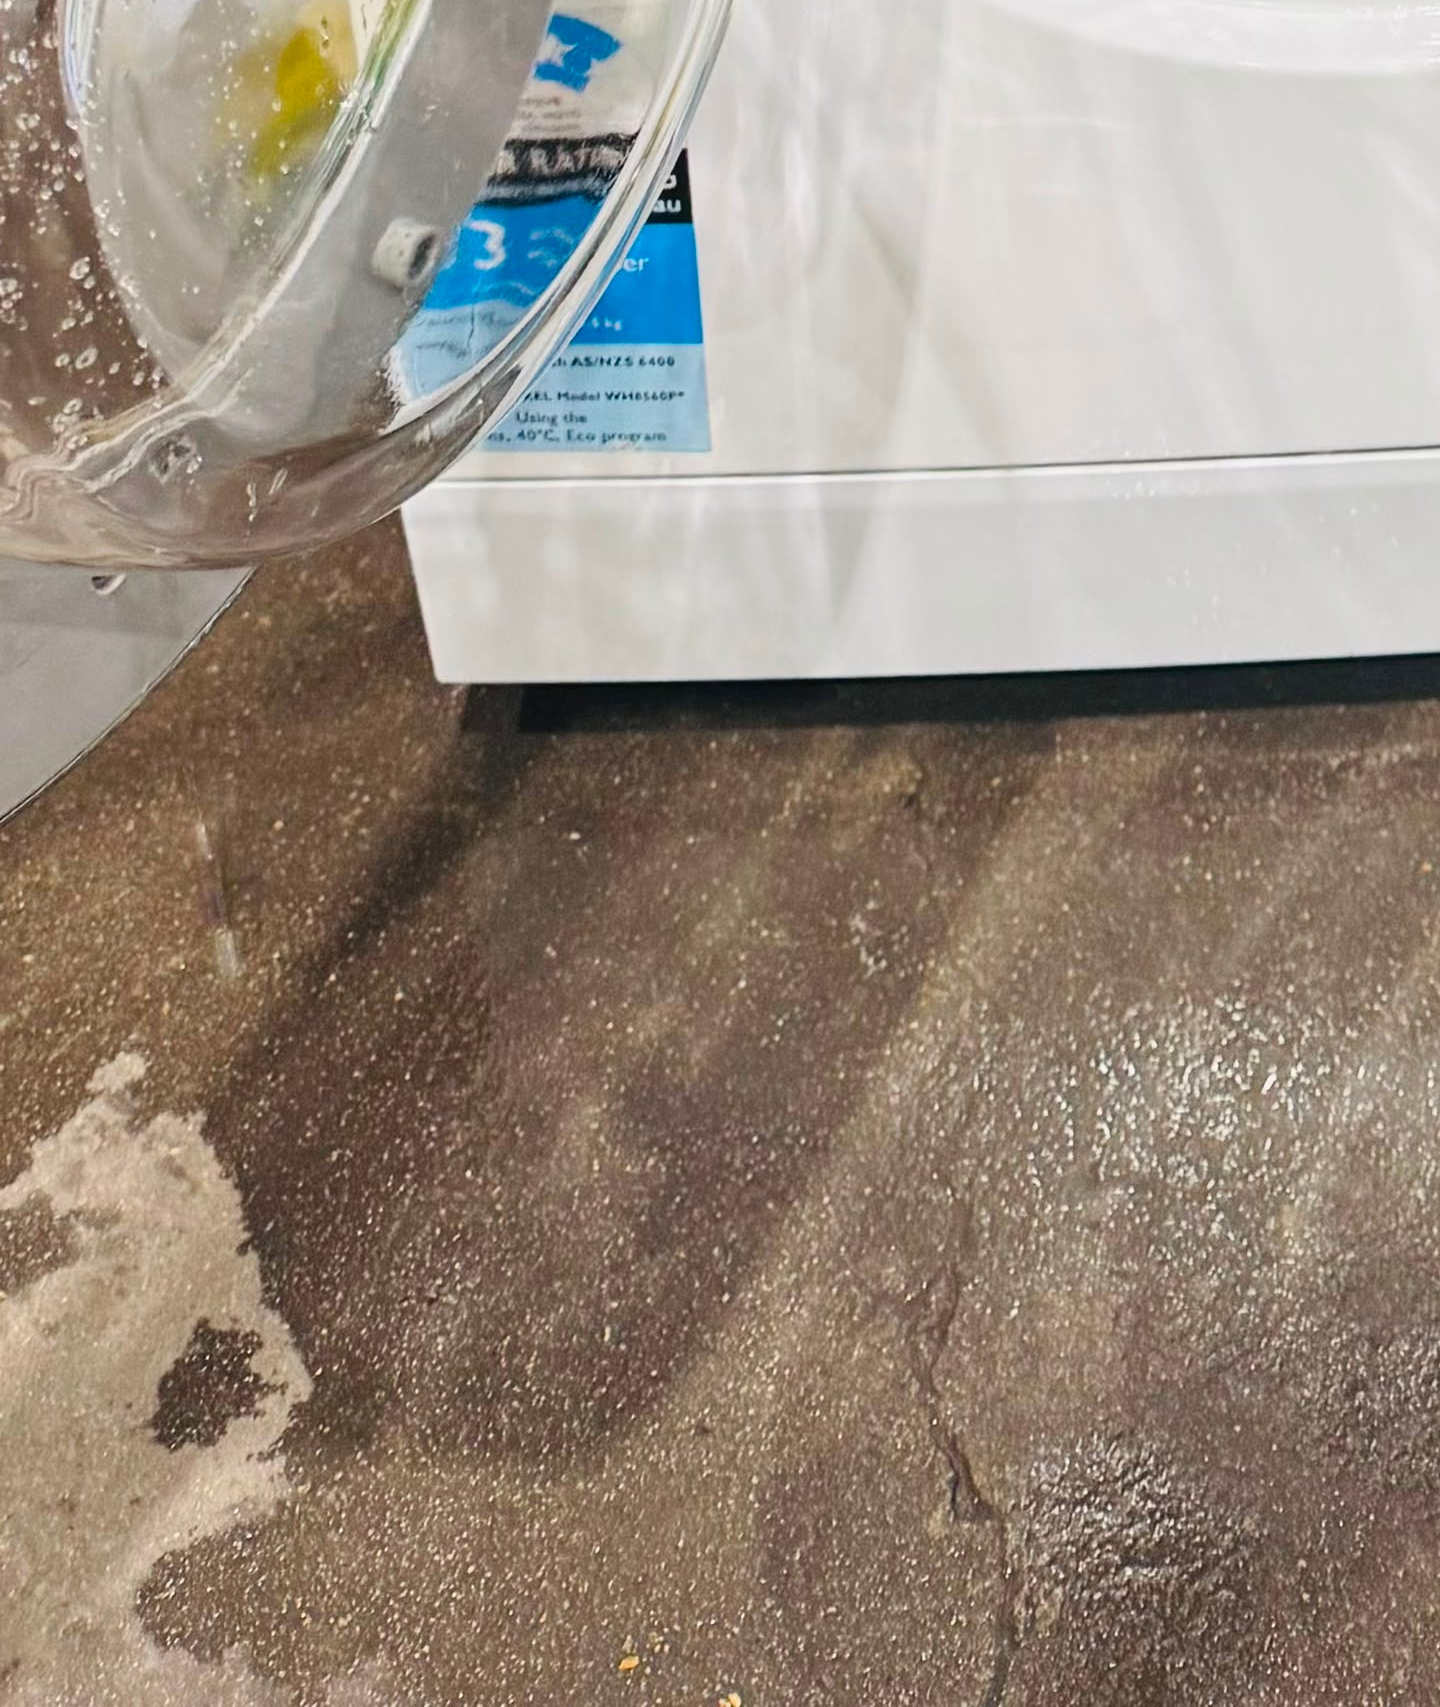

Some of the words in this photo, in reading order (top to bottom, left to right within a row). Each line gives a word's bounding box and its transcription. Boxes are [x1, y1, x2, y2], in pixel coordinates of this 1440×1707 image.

[570, 356, 633, 367] AS/NZS
[639, 356, 674, 367] 6400
[558, 391, 599, 400] Model
[516, 413, 557, 425] Using
[563, 412, 587, 422] the
[567, 430, 595, 441] Eco
[602, 431, 666, 444] program
